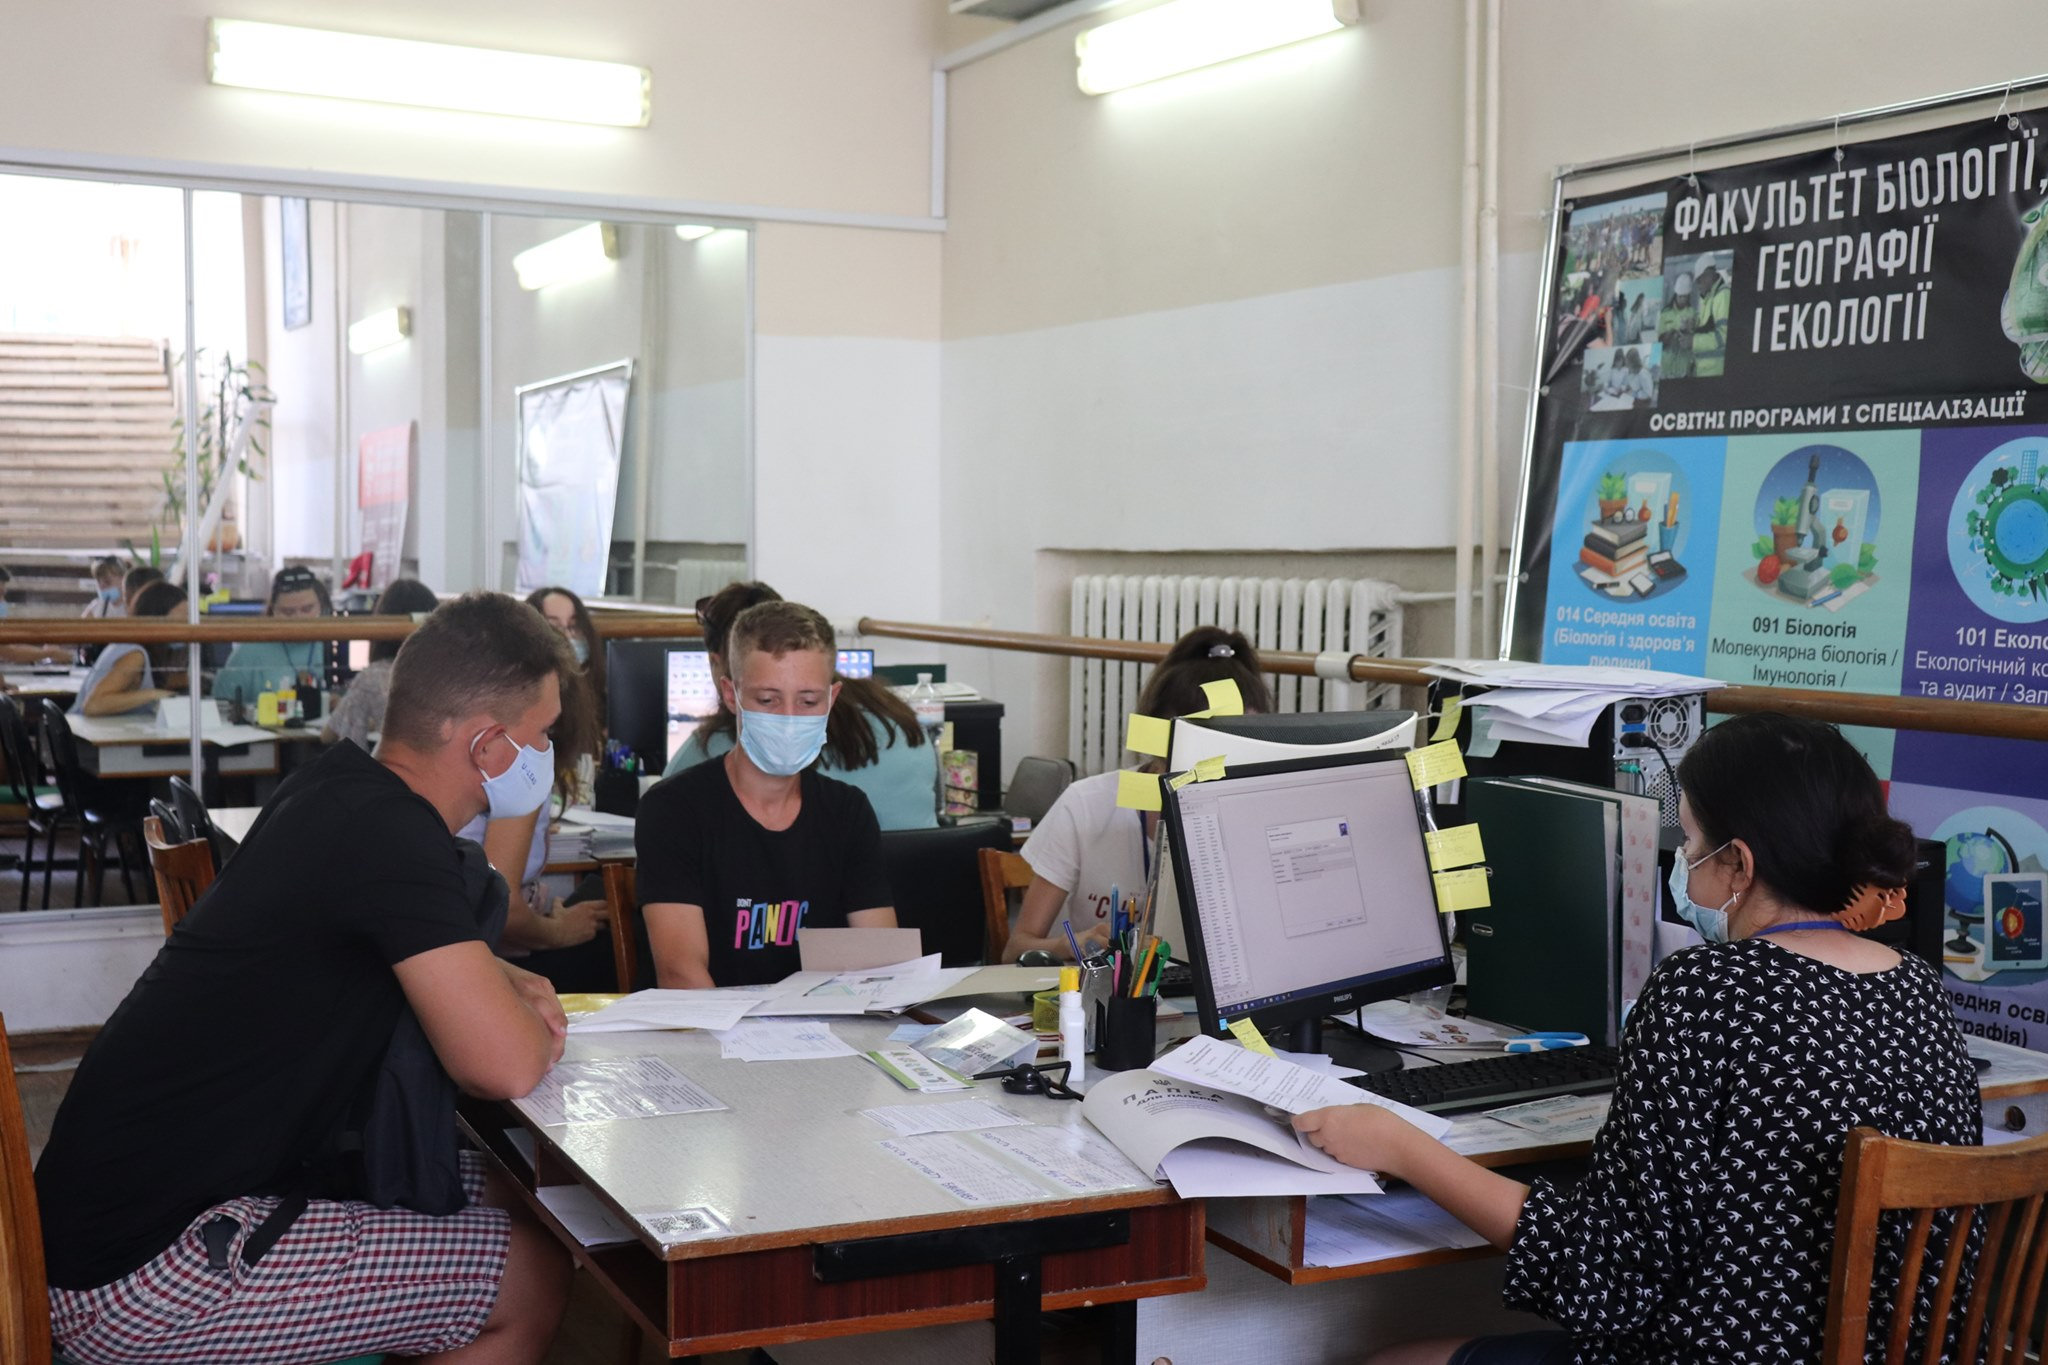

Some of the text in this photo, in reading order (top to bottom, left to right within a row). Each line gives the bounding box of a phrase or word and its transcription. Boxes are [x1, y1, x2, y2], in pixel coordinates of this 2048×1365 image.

[1673, 127, 2048, 241] ФАКУЛЬТЕТ БІОЛОГІЇ,
[1756, 214, 1940, 292] ГЕОГРАФІЇ
[1751, 282, 1933, 353] І ЕКОЛОГІЇ
[1650, 390, 2028, 432] ОСВІТНІ ПРОГРАМИ І СПЕЦІАЛІЗАЦІЇ
[1556, 606, 1696, 629] 014 Середня освіта
[1752, 616, 1857, 638] 091 Біологія
[1554, 627, 1616, 647] (Біологія
[1619, 631, 1624, 647] і
[1955, 627, 1987, 646] 101
[1712, 637, 1816, 663] Молекулярна
[1821, 645, 1887, 666] біологія
[1915, 650, 2026, 676] Екологічний
[1753, 664, 1836, 687] Імунологія
[1919, 680, 1939, 696] та
[1943, 682, 1997, 701] аудит
